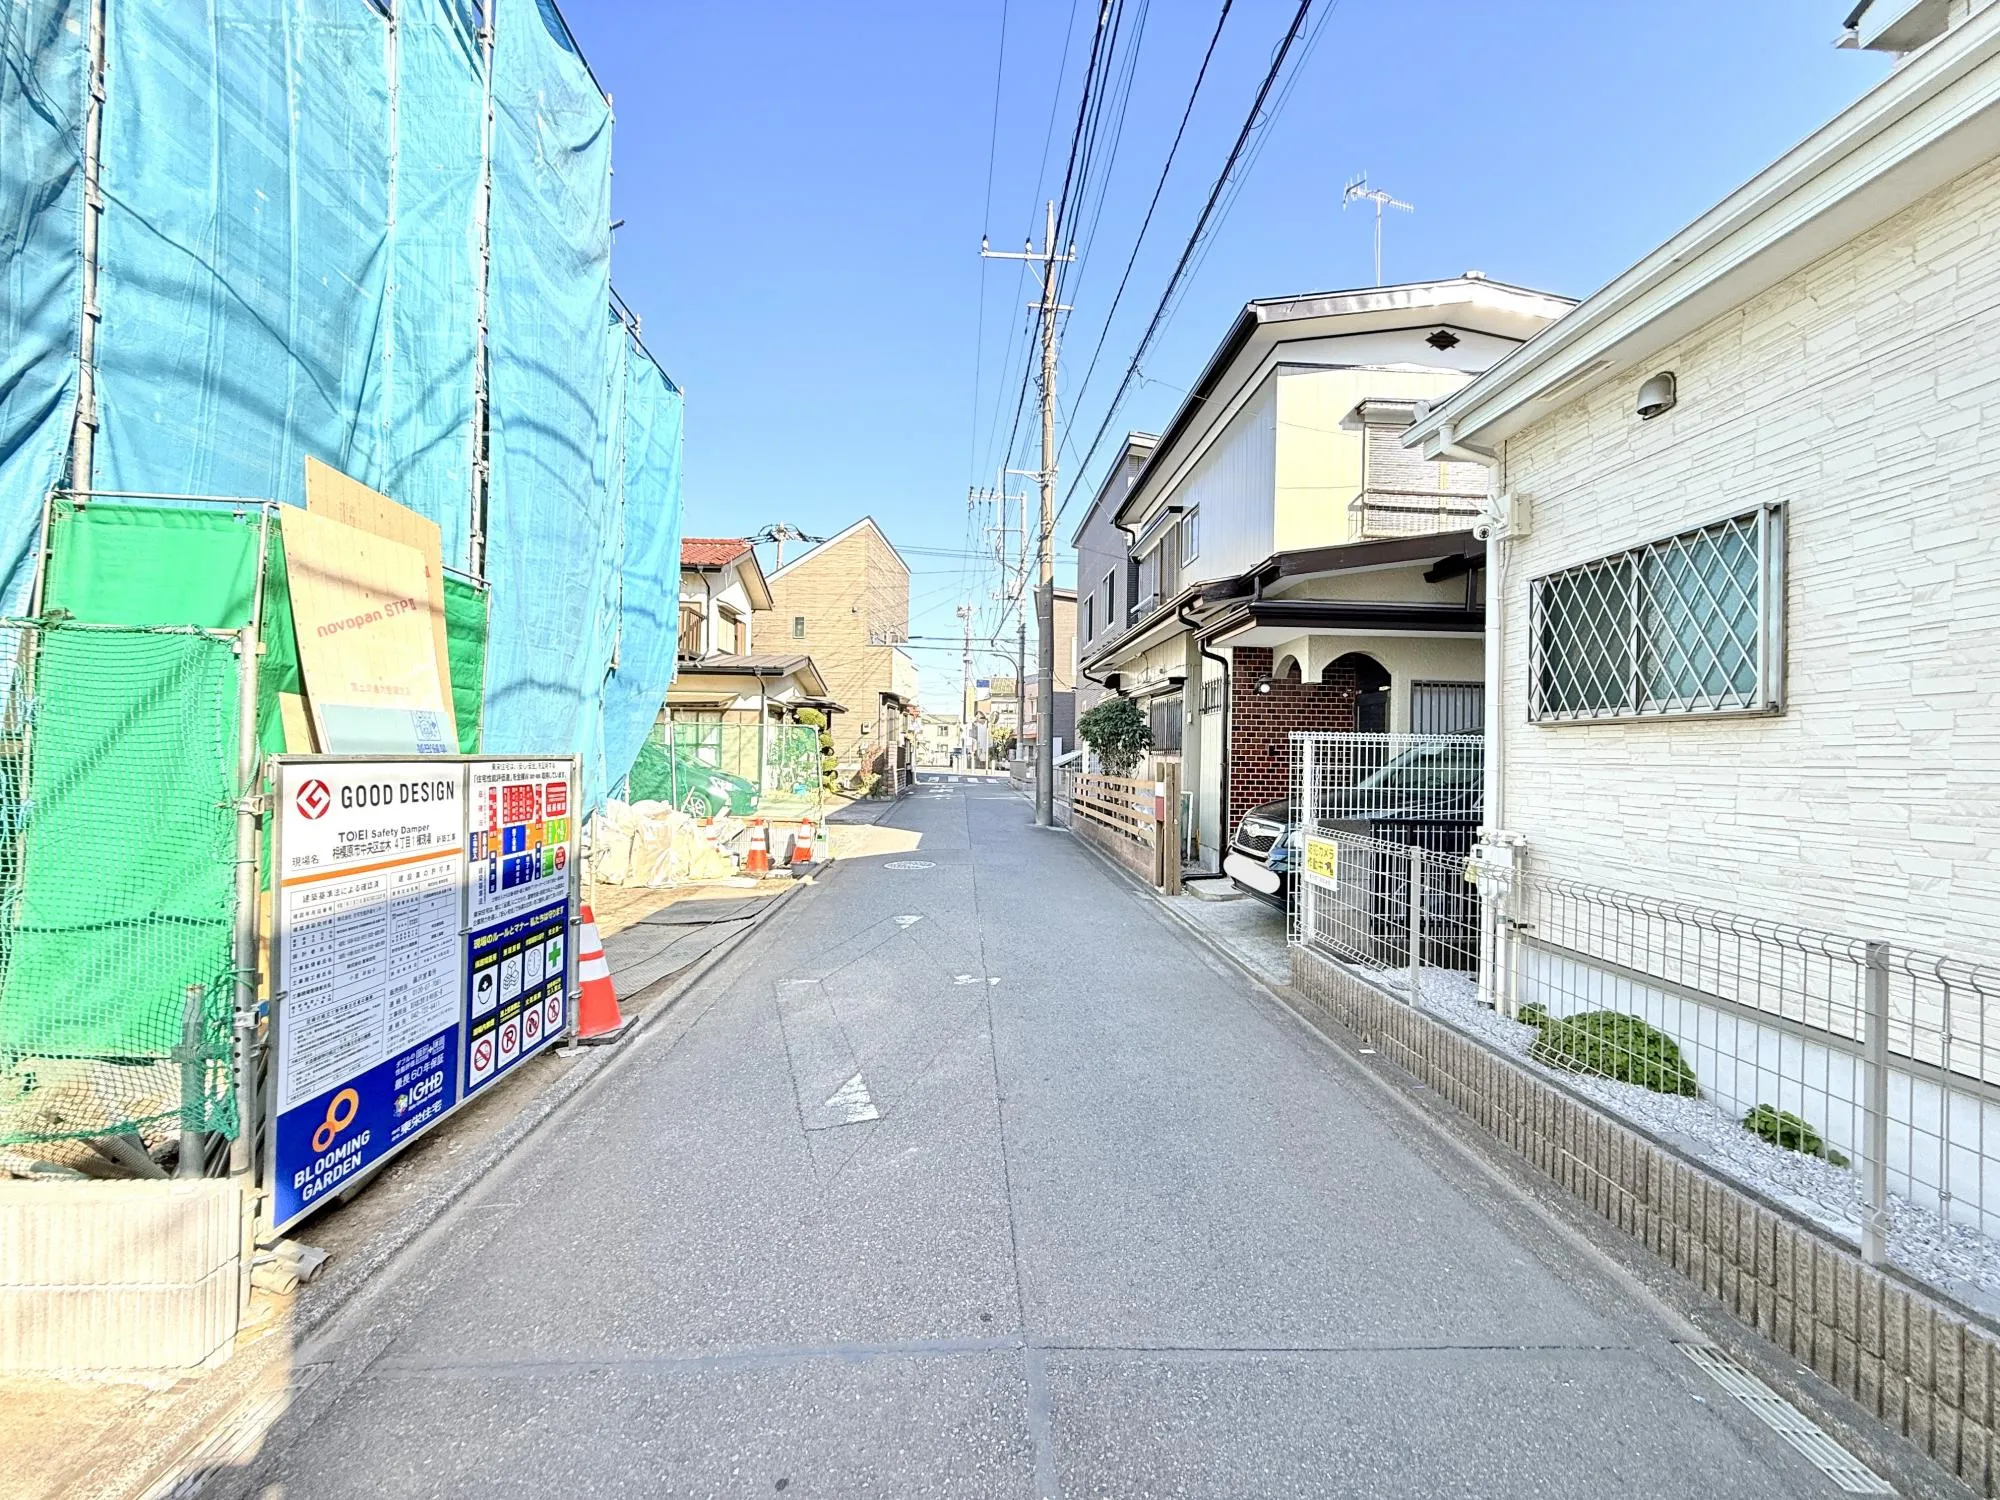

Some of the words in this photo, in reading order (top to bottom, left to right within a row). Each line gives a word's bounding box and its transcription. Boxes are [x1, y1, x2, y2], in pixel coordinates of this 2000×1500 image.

[316, 610, 383, 638] novopan
[341, 784, 393, 809] GOOD
[400, 781, 454, 803] DESIGN
[371, 828, 398, 839] Safety
[401, 824, 430, 834] Damper
[292, 855, 319, 867] 現場名
[474, 922, 530, 949] 現場のルールとマナー
[395, 1053, 445, 1090] 最長60年保証
[399, 1099, 443, 1136] 東栄住宅
[294, 1129, 371, 1190] BLOOMING
[302, 1151, 362, 1202] GARDEN
